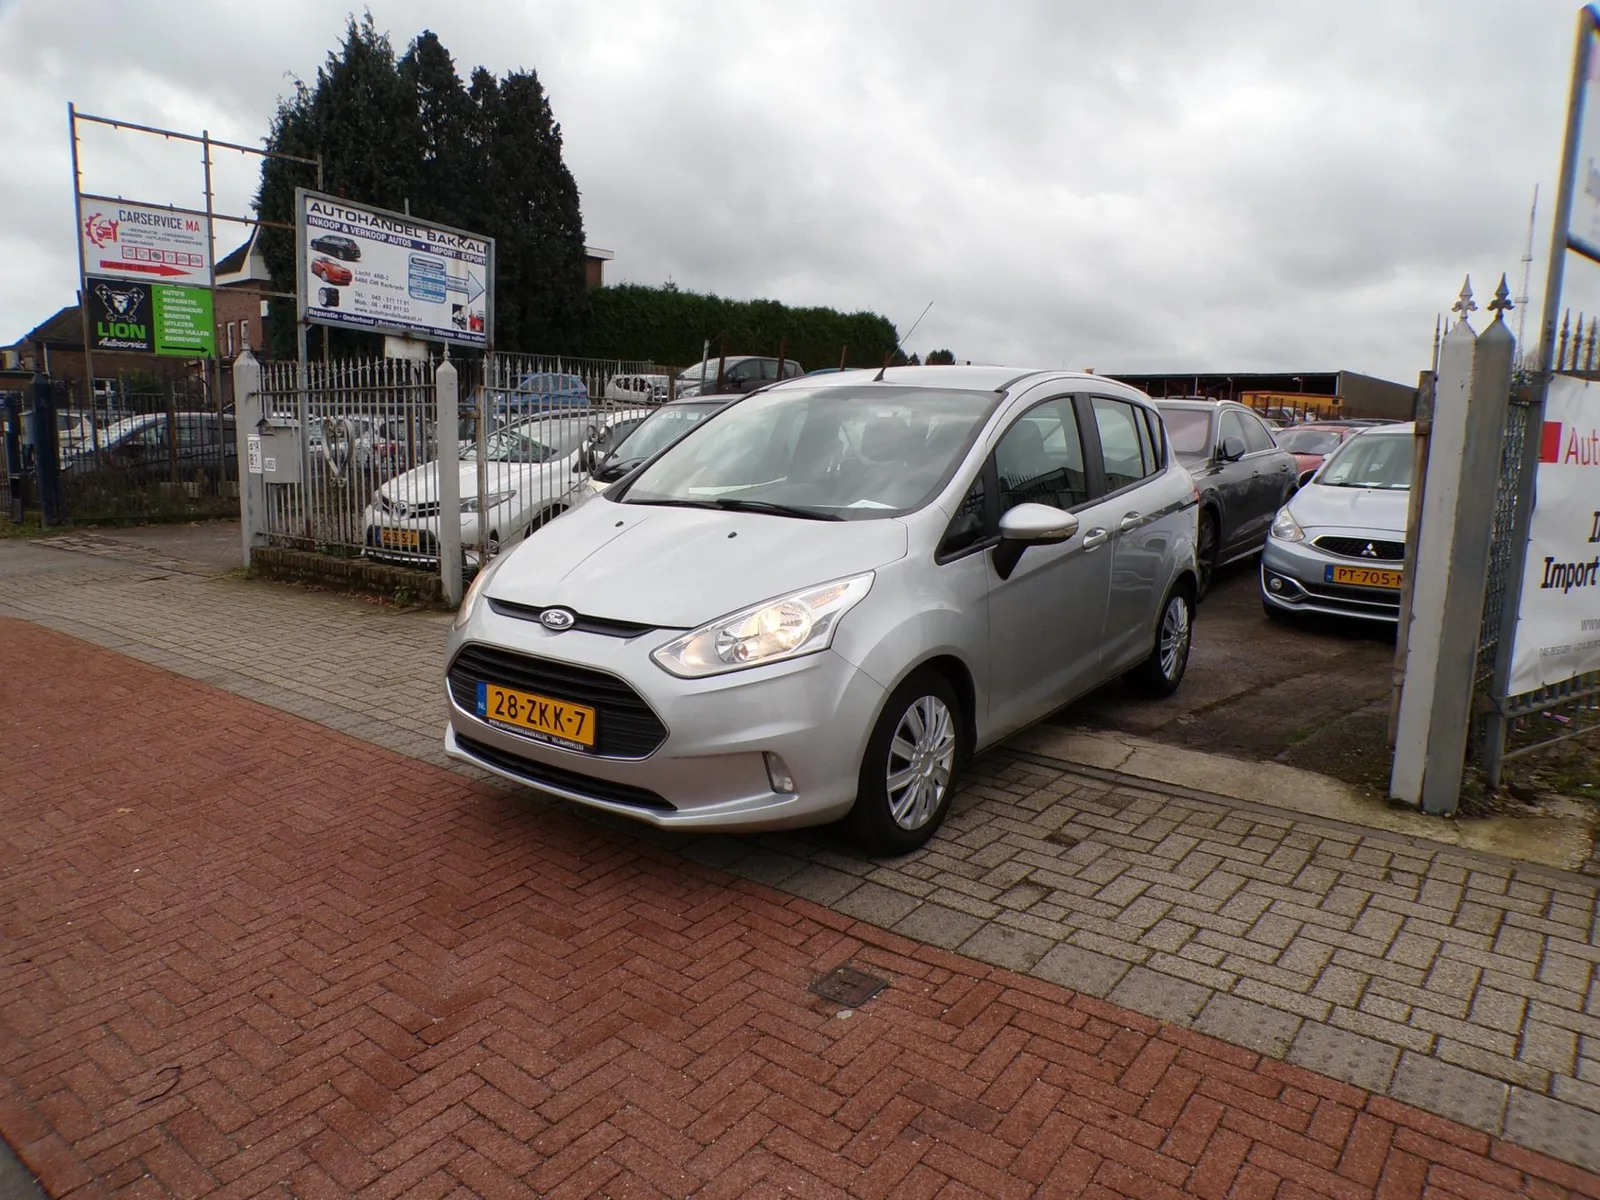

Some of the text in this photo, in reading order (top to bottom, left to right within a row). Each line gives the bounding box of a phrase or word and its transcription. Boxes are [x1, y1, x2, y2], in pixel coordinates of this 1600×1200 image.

[119, 209, 200, 232] CARSERVICE MA
[311, 202, 486, 254] AUTOHANDEL BAKKALI
[309, 216, 486, 265] INKOOP & VERKOOP AUTOS IMPORT EXPORT
[163, 313, 191, 321] BANDEN
[308, 308, 339, 320] Reparatie
[342, 314, 374, 325] Onderhoud
[97, 320, 147, 339] LION
[98, 337, 148, 350] Autoservice
[1564, 426, 1600, 466] Aut
[1588, 511, 1600, 543] I
[1540, 556, 1600, 595] Import
[545, 611, 565, 625] Ford
[477, 701, 486, 711] NL
[494, 690, 586, 736] 28-ZKK-7
